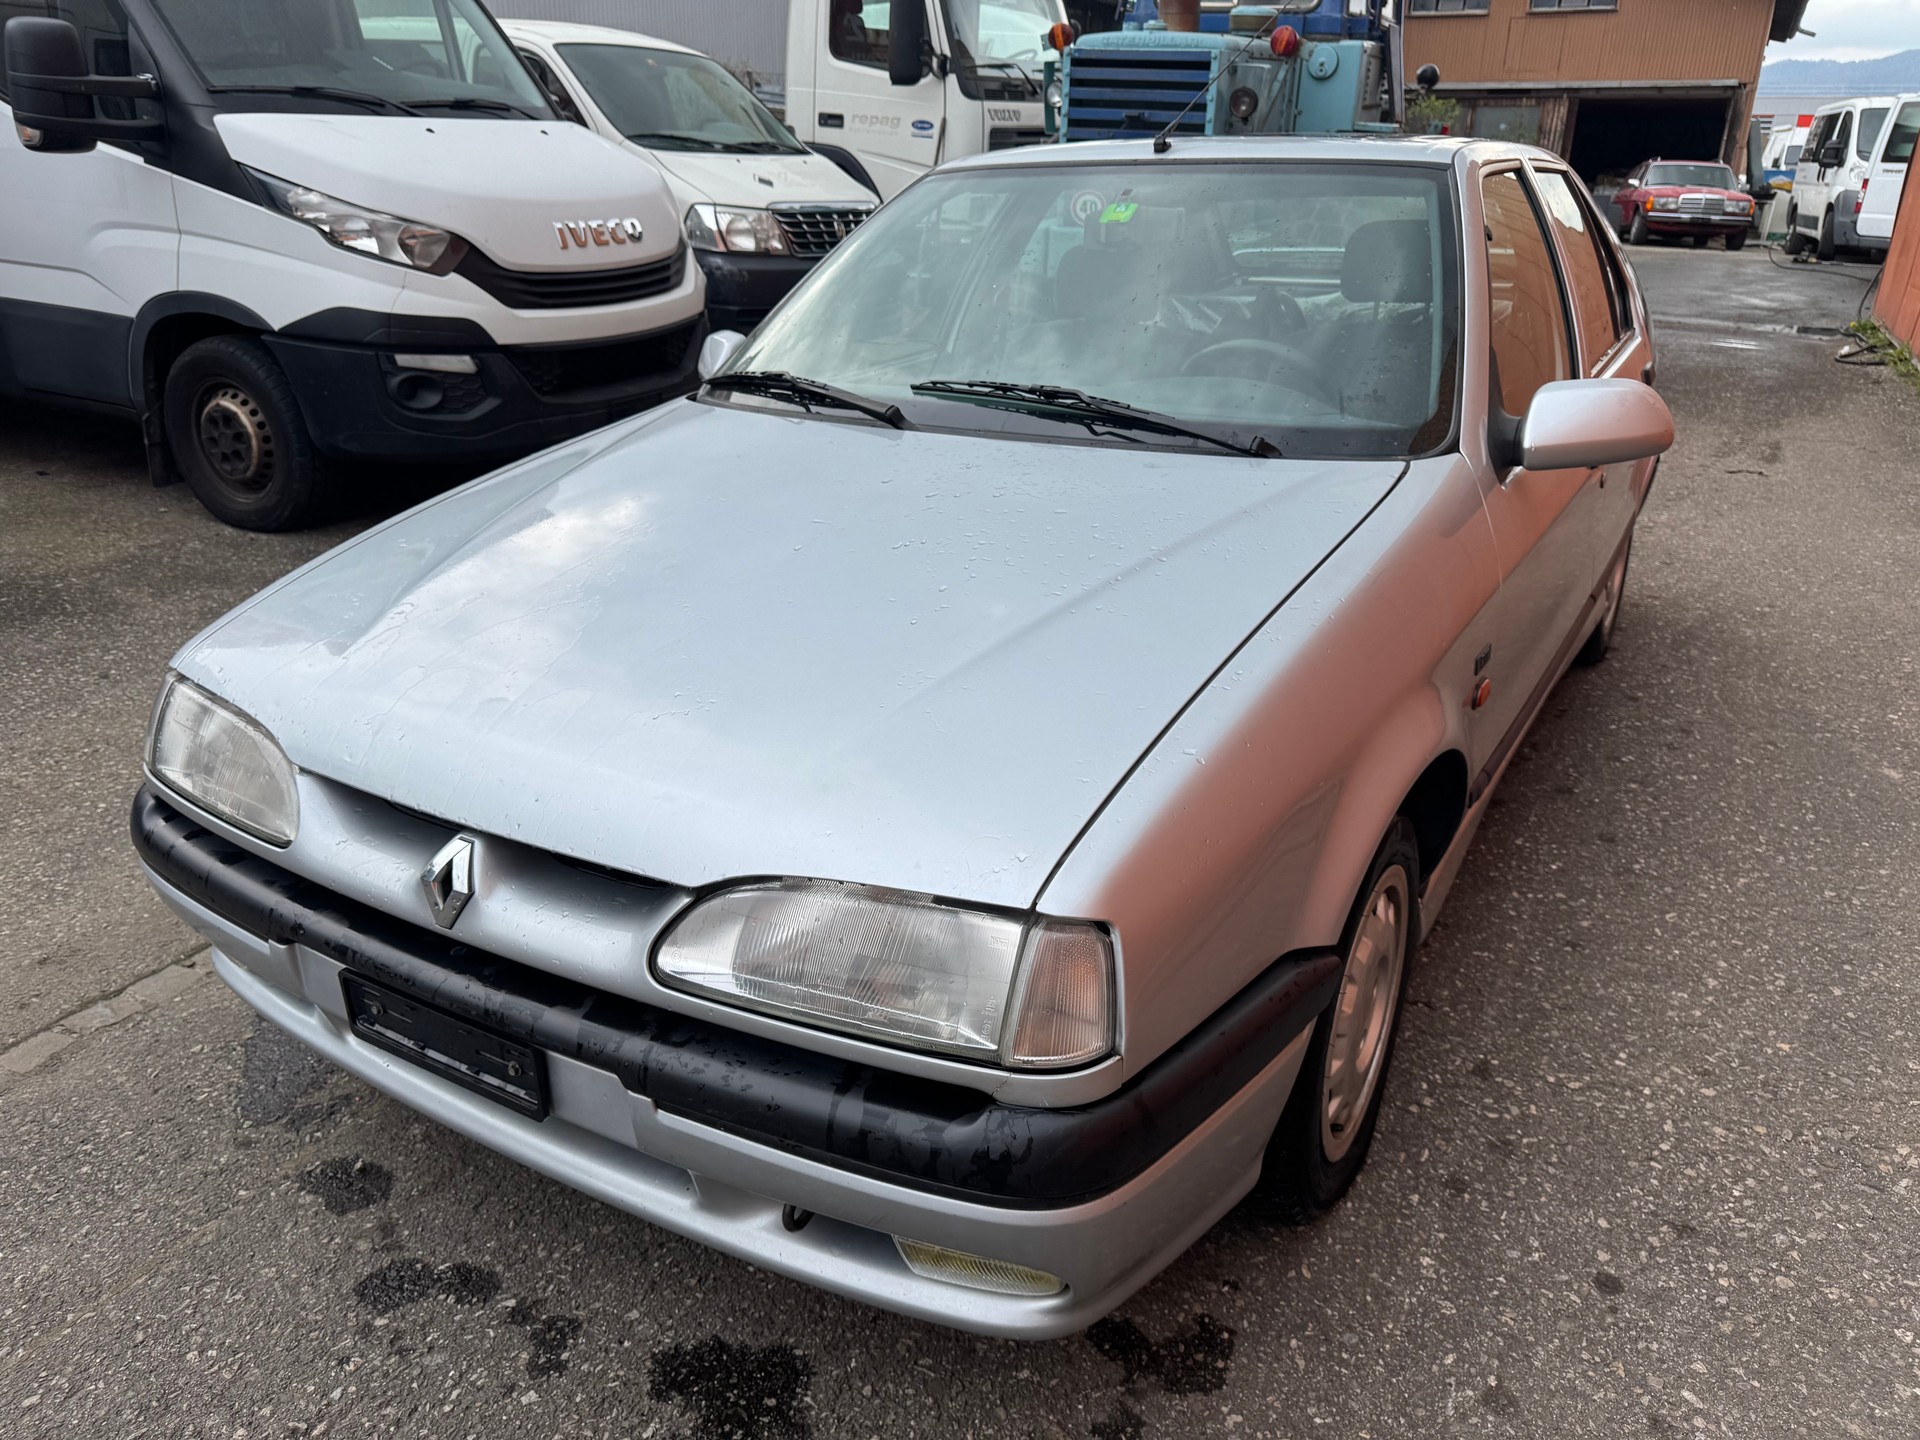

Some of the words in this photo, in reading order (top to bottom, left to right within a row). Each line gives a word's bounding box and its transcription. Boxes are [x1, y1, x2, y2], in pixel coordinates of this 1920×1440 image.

[1102, 34, 1199, 48] CATERPILLAR
[852, 113, 901, 129] repag
[987, 108, 1021, 122] VOLVO
[1080, 200, 1098, 214] 40
[552, 217, 643, 250] IVECO
